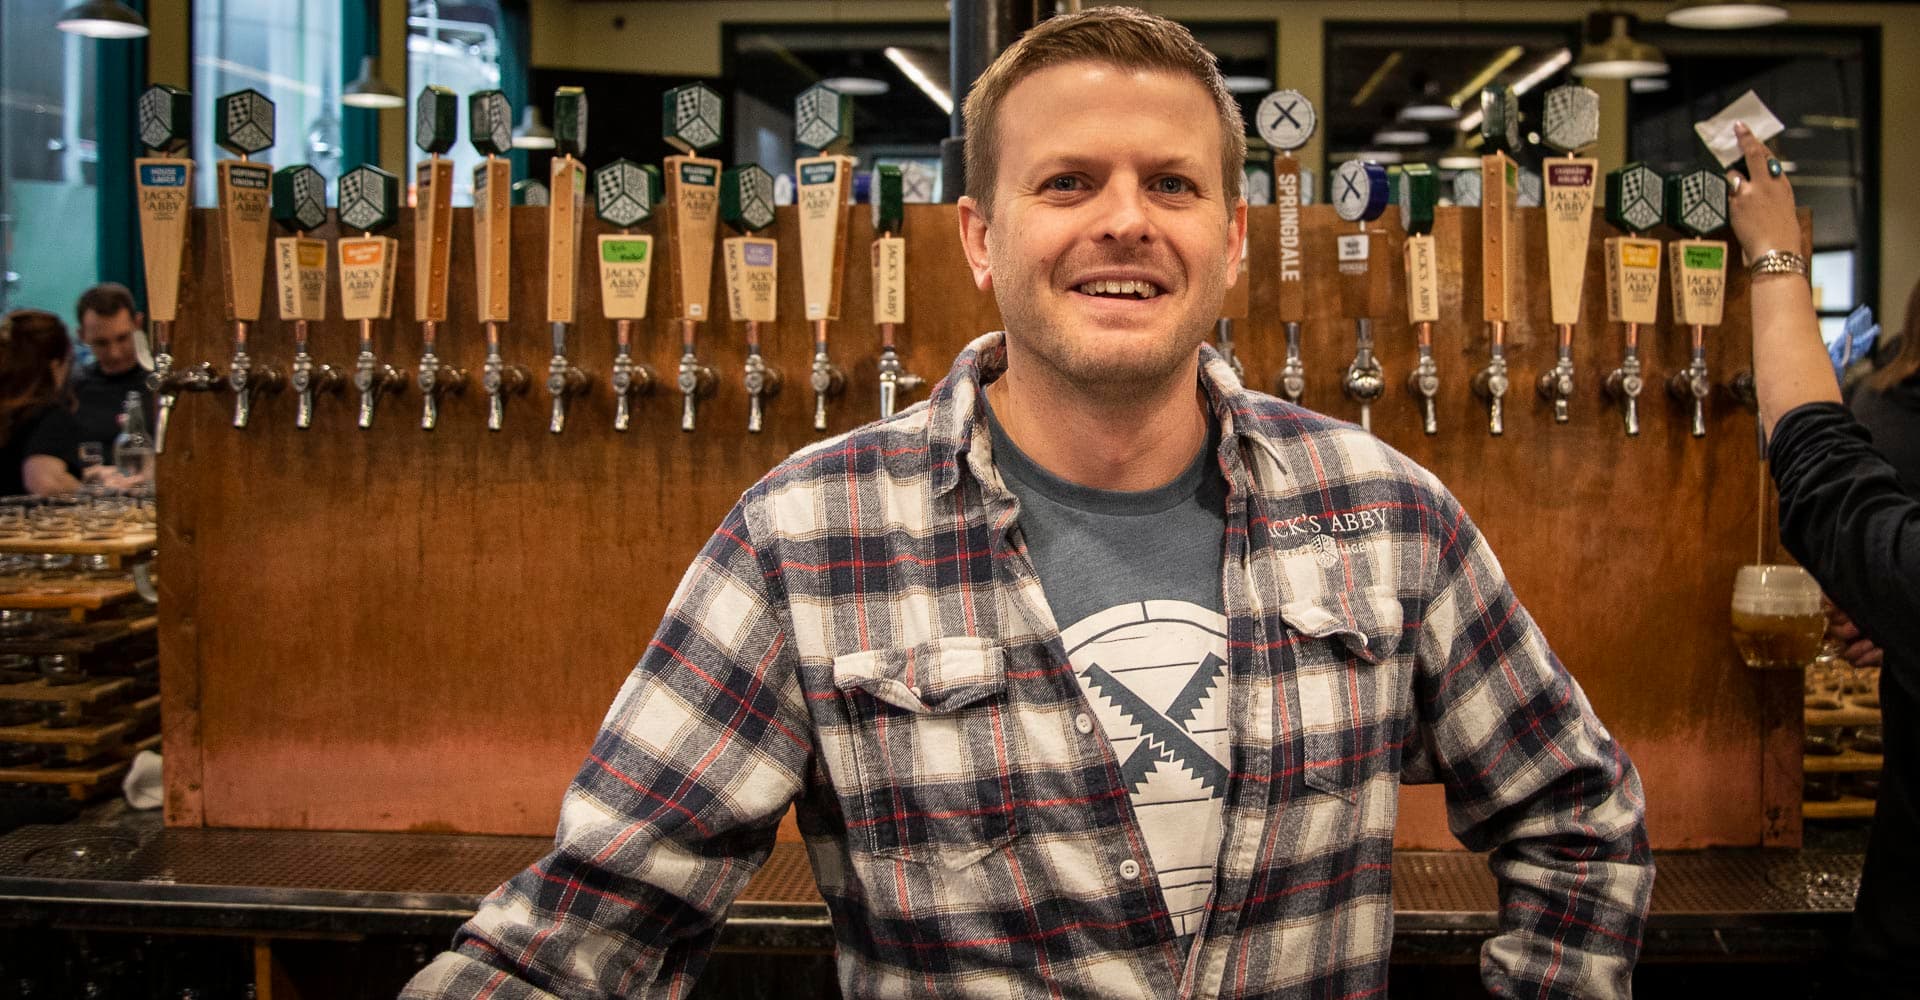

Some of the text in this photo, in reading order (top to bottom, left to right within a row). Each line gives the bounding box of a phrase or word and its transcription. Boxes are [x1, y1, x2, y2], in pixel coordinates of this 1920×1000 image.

[144, 190, 186, 203] JACK'S
[681, 188, 717, 201] JACK'S
[801, 187, 836, 202] JACK'S
[1550, 190, 1592, 201] JACK'S
[147, 200, 181, 212] ABBY
[684, 200, 713, 212] ABBY
[805, 199, 833, 210] ABBY
[1554, 200, 1586, 213] ABBY
[1278, 173, 1300, 282] SPRINGDALE
[279, 242, 297, 315] JACK'S ABBY
[344, 269, 381, 283] JACK'S
[605, 266, 647, 281] JACK'S
[1415, 242, 1431, 316] JACK'S ABBY
[1624, 271, 1658, 284] JACK'S
[347, 280, 377, 291] ABBY
[608, 279, 641, 291] ABBY
[728, 243, 745, 318] JACK'S ABBY
[883, 244, 898, 318] JACK'S ABBY
[1686, 274, 1723, 288] JACK'S
[1626, 283, 1653, 296] ABBY
[1690, 286, 1719, 299] ABBY
[1331, 507, 1387, 533] ABBY
